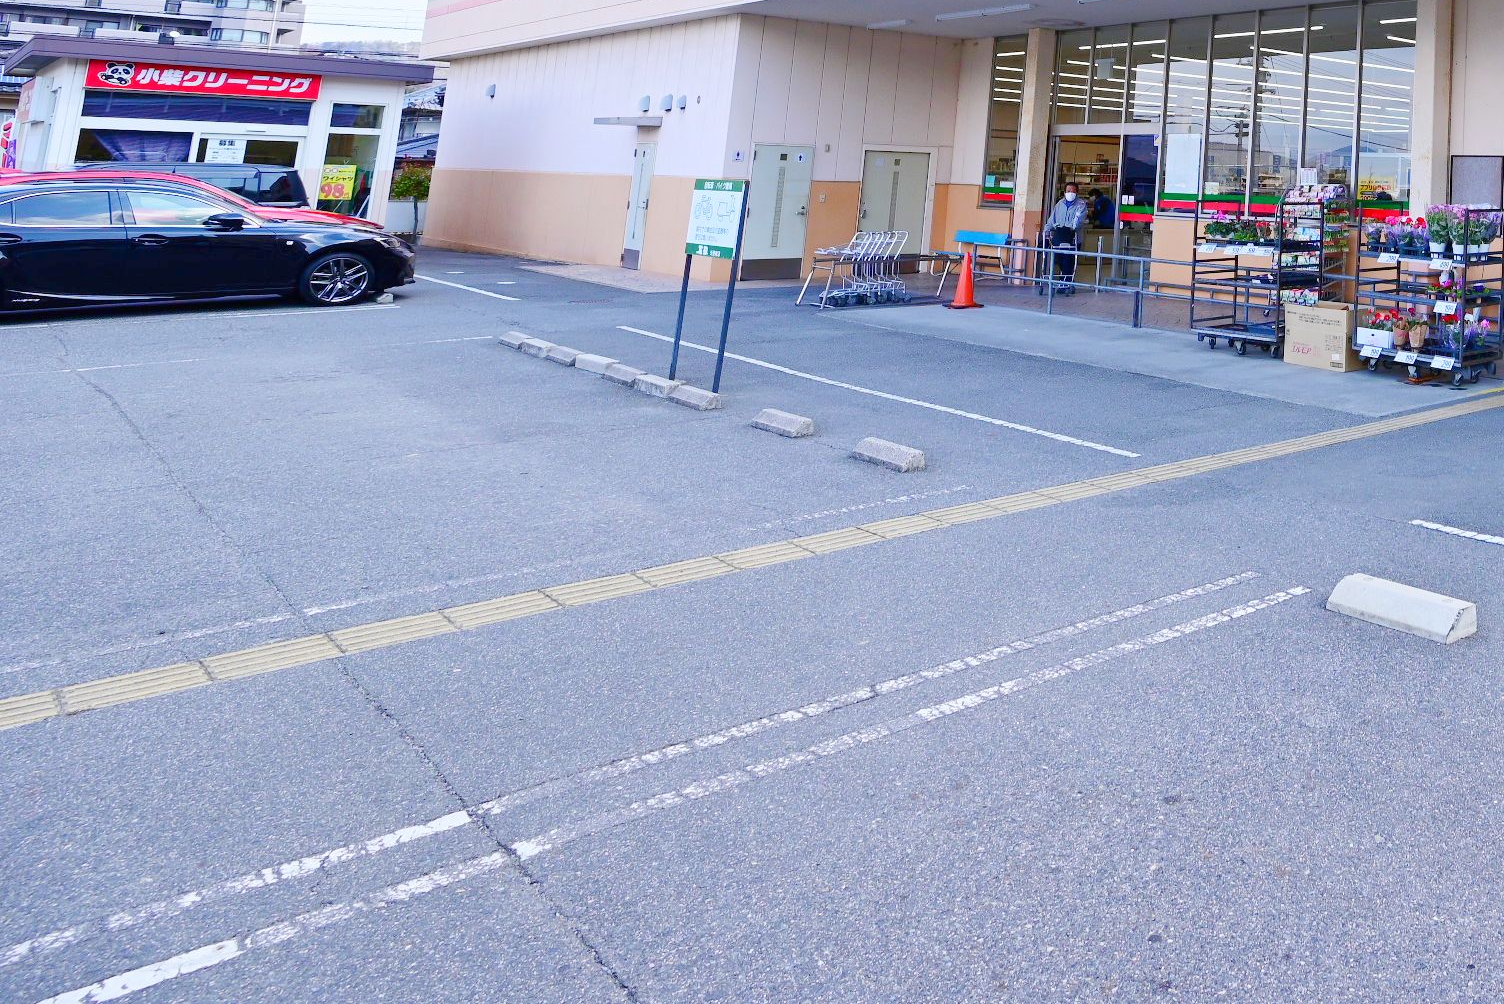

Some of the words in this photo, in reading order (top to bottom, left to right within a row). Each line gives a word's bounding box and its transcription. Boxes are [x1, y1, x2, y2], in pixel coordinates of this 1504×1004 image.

[136, 67, 312, 93] 小柴クリーニング
